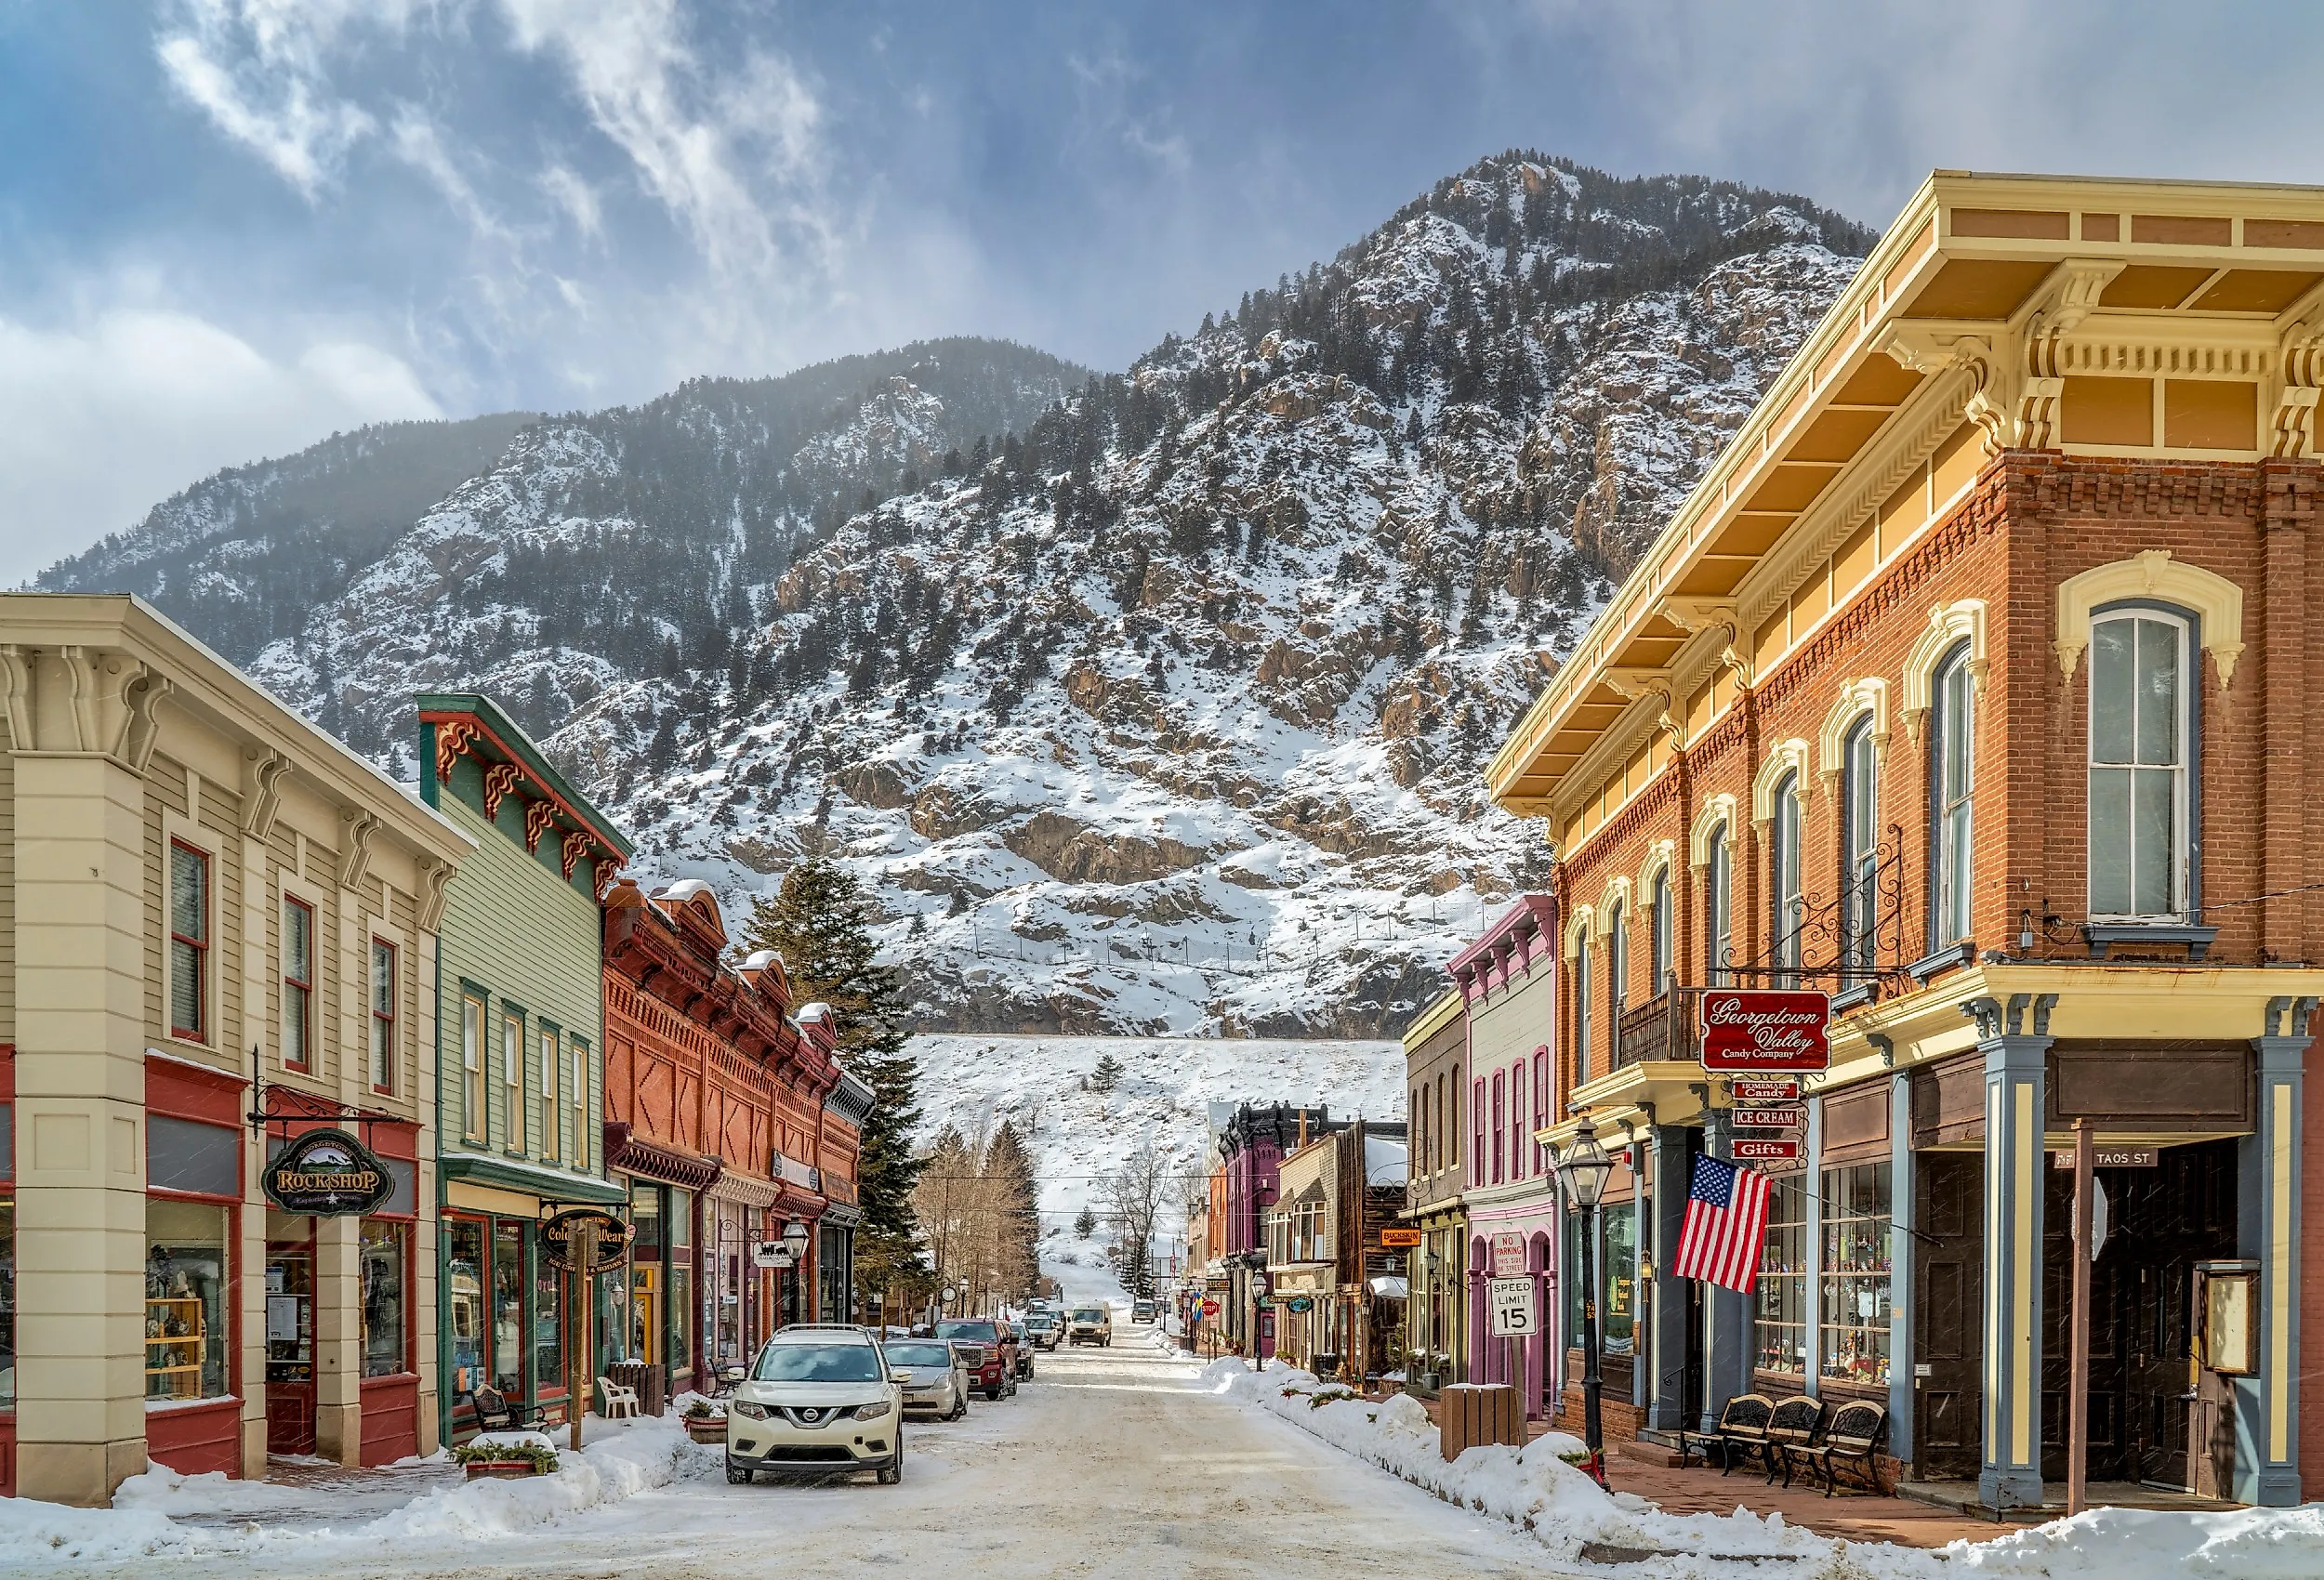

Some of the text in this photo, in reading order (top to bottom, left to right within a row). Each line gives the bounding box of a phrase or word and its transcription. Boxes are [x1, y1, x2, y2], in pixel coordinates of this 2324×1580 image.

[1710, 997, 1820, 1034] Georgetown
[1754, 1026, 1814, 1055] Valley
[1722, 1048, 1794, 1060] Candy Company
[1744, 1088, 1787, 1099] Candy
[1736, 1111, 1794, 1124] ICE CREAM
[299, 1140, 354, 1158] GEORGETOWN
[1740, 1143, 1784, 1155] Gifts
[2096, 1153, 2149, 1164] TAOS ST
[278, 1171, 379, 1192] ROCK SHOP
[598, 1229, 624, 1242] Wear
[1383, 1231, 1419, 1240] BUCKSKIN
[1501, 1236, 1513, 1245] NO
[1496, 1245, 1522, 1256] PARKING
[548, 1257, 561, 1269] ICE
[597, 1259, 623, 1271] SODAS
[1506, 1264, 1523, 1272] STREET
[1494, 1283, 1530, 1293] SPEED
[1498, 1295, 1526, 1305] LIMIT
[1500, 1308, 1527, 1329] 15
